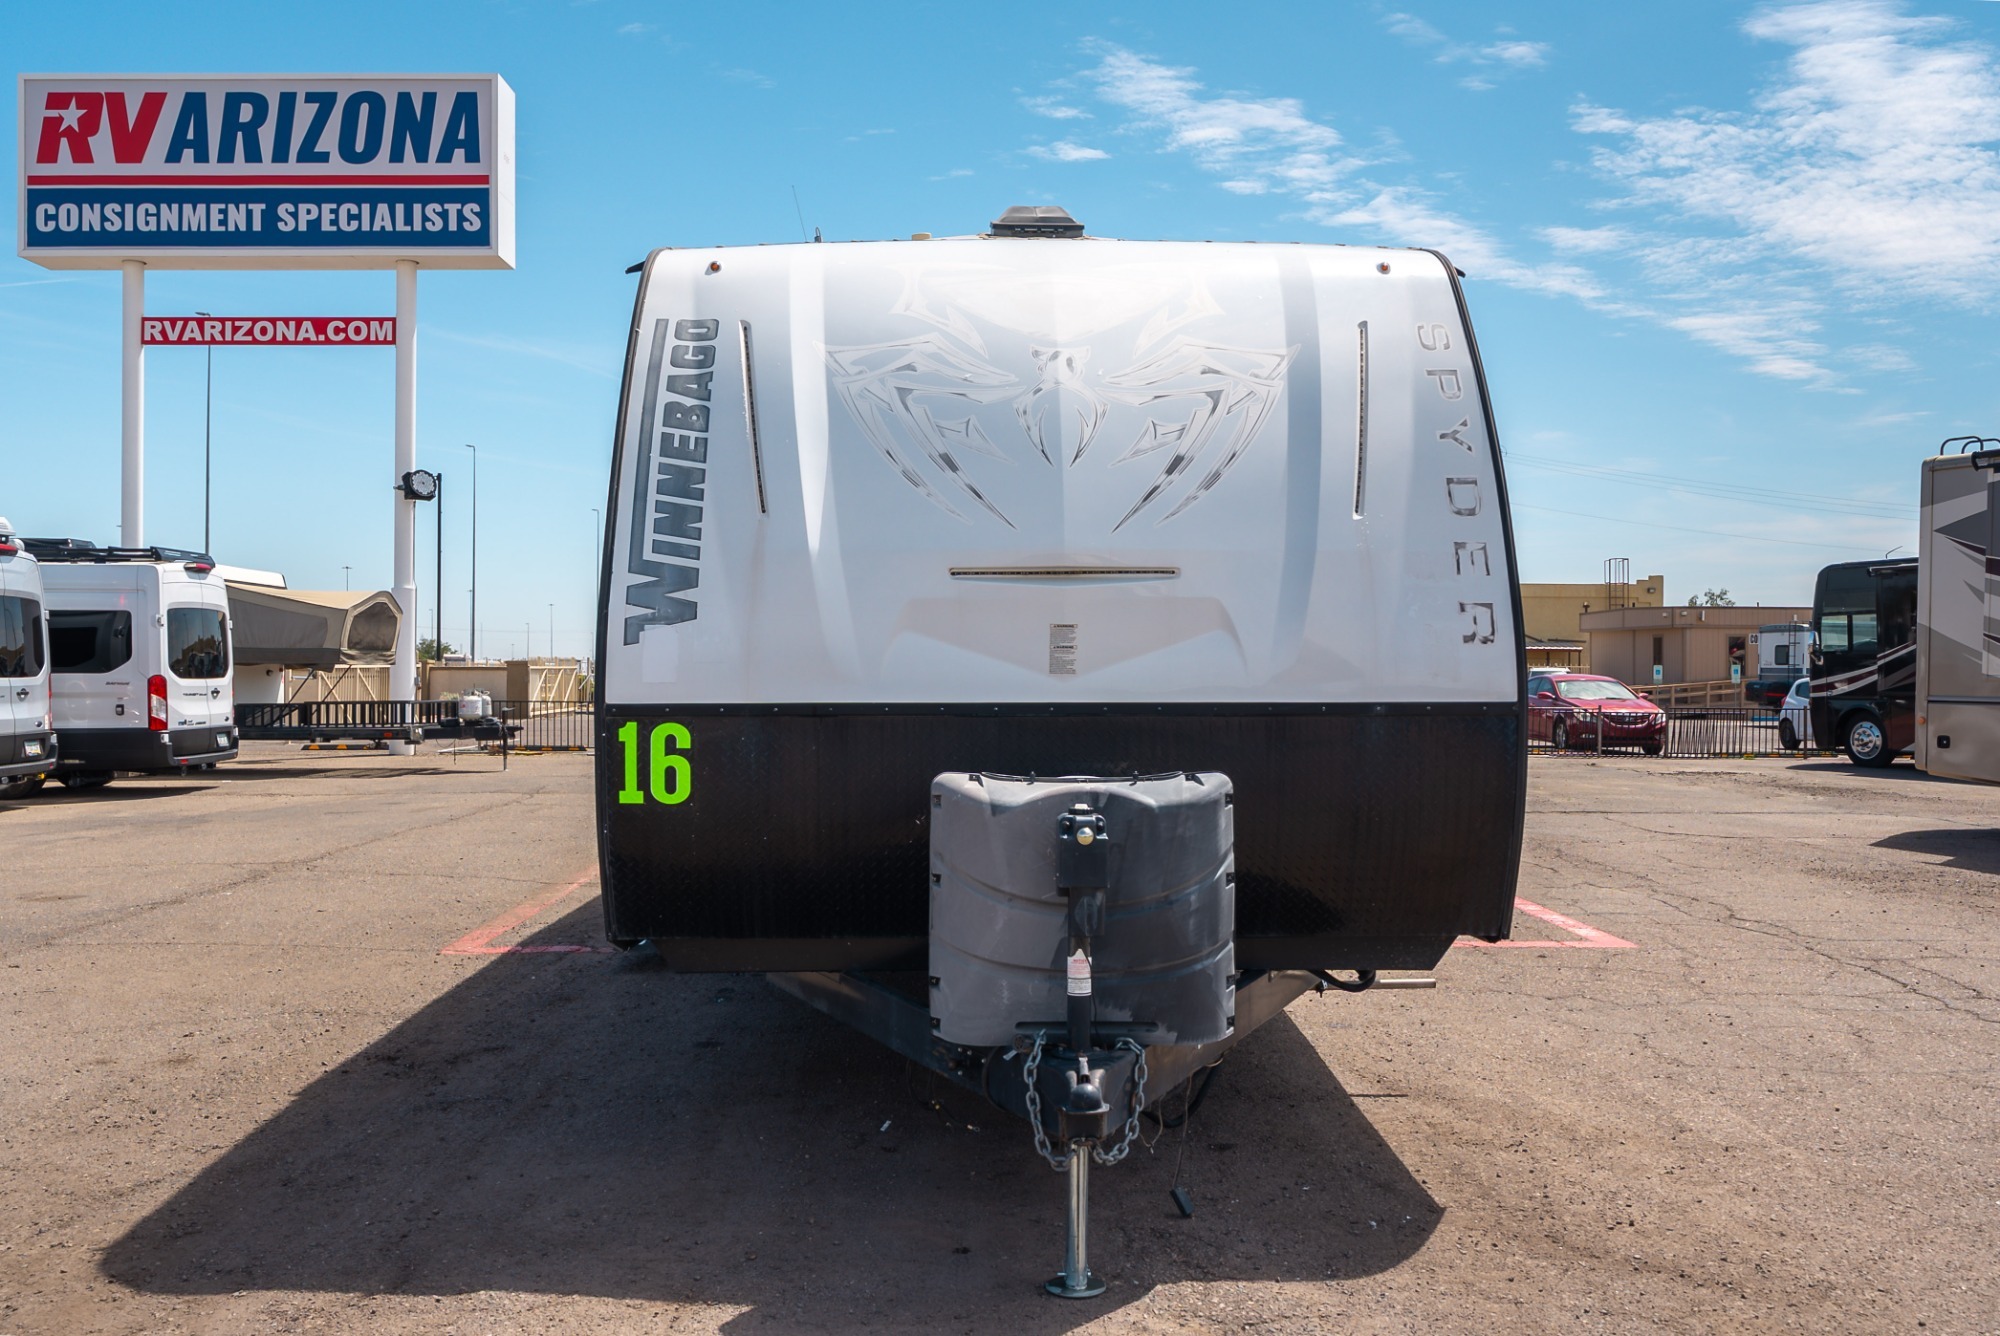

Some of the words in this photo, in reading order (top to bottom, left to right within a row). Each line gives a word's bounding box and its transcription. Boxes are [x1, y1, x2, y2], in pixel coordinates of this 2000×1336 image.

[35, 203, 266, 232] CONSIGNMENT
[277, 202, 482, 232] SPECIALISTS
[143, 320, 393, 342] RVARIZONA.COM
[623, 318, 719, 646] WINNEBAGO
[1415, 323, 1497, 645] SPYDER
[618, 721, 692, 805] 16
